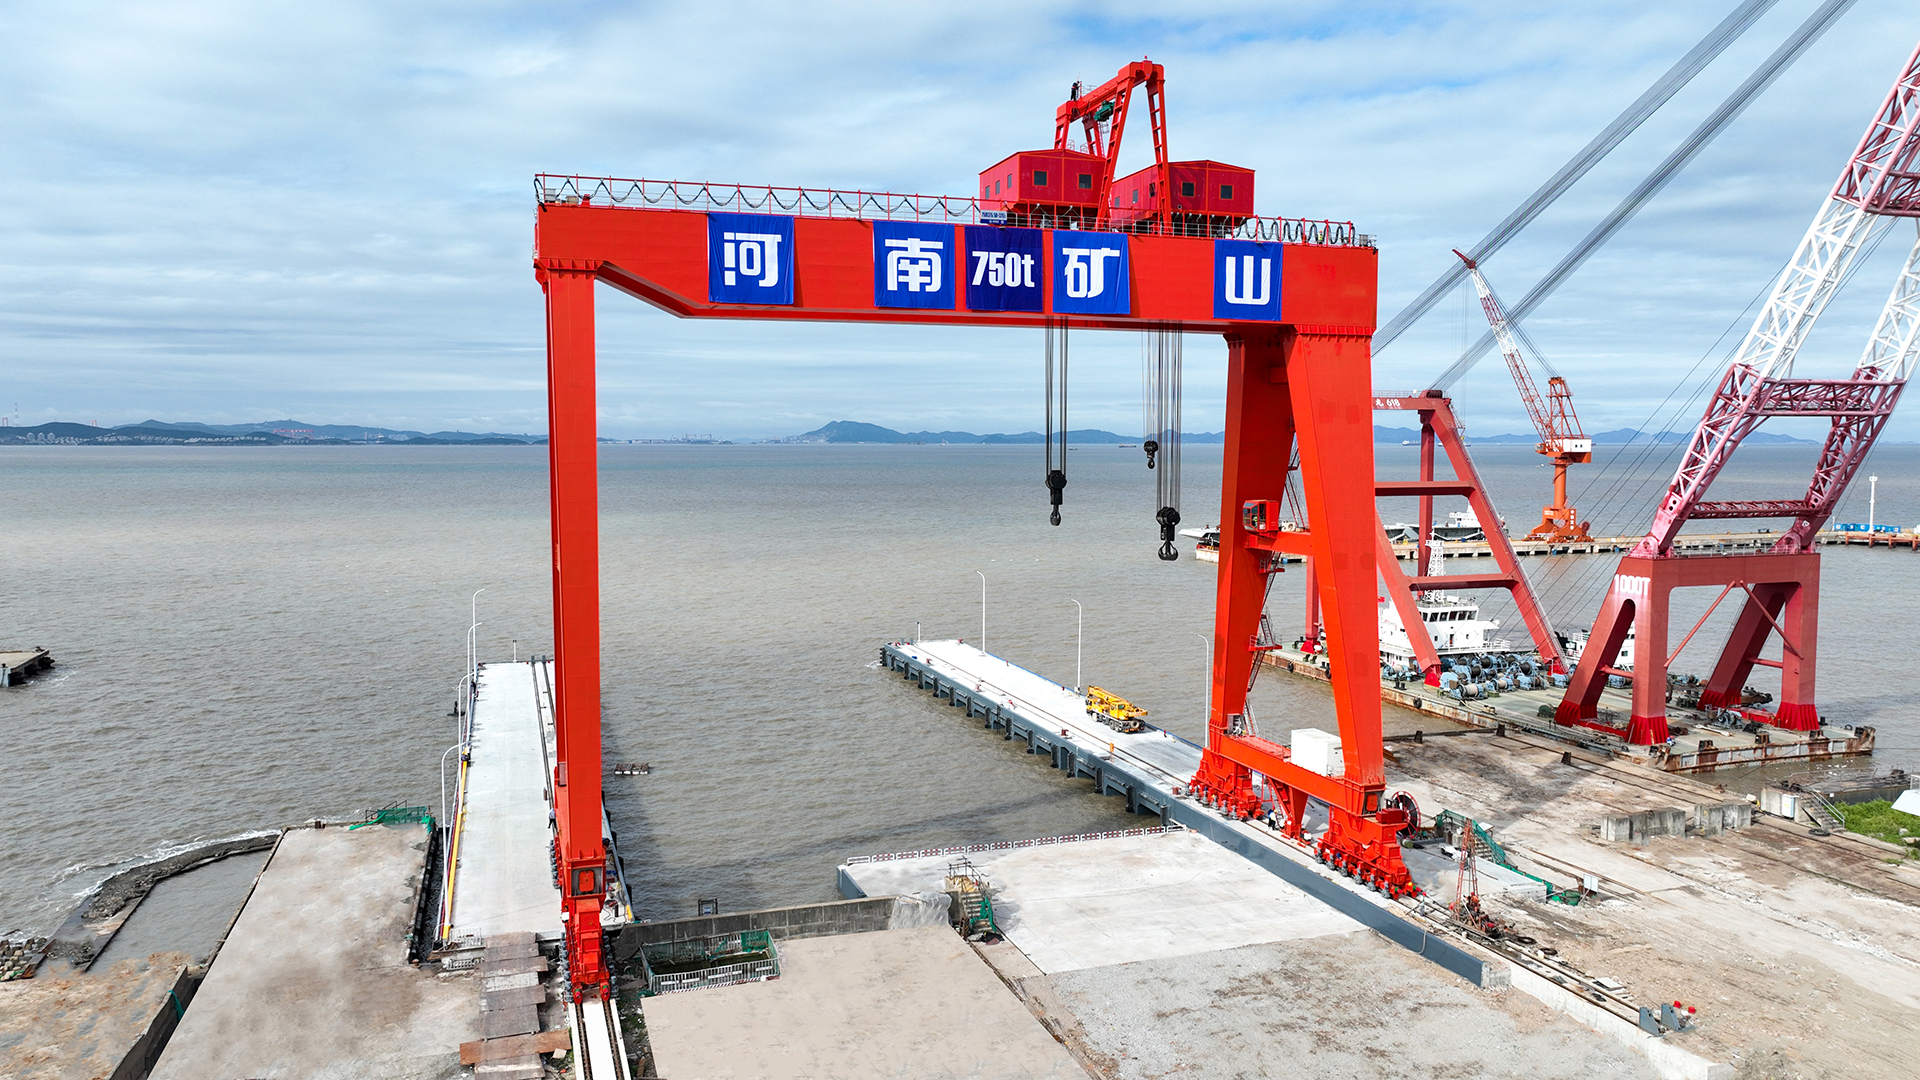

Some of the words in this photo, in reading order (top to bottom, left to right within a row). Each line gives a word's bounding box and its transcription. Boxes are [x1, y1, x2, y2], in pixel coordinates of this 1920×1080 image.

[724, 232, 782, 287] 河
[885, 238, 943, 292] 南
[971, 251, 1034, 288] 750t
[1062, 248, 1120, 298] 矿
[1225, 255, 1271, 305] 山
[1386, 399, 1401, 407] 618
[1614, 574, 1651, 596] 1000T
